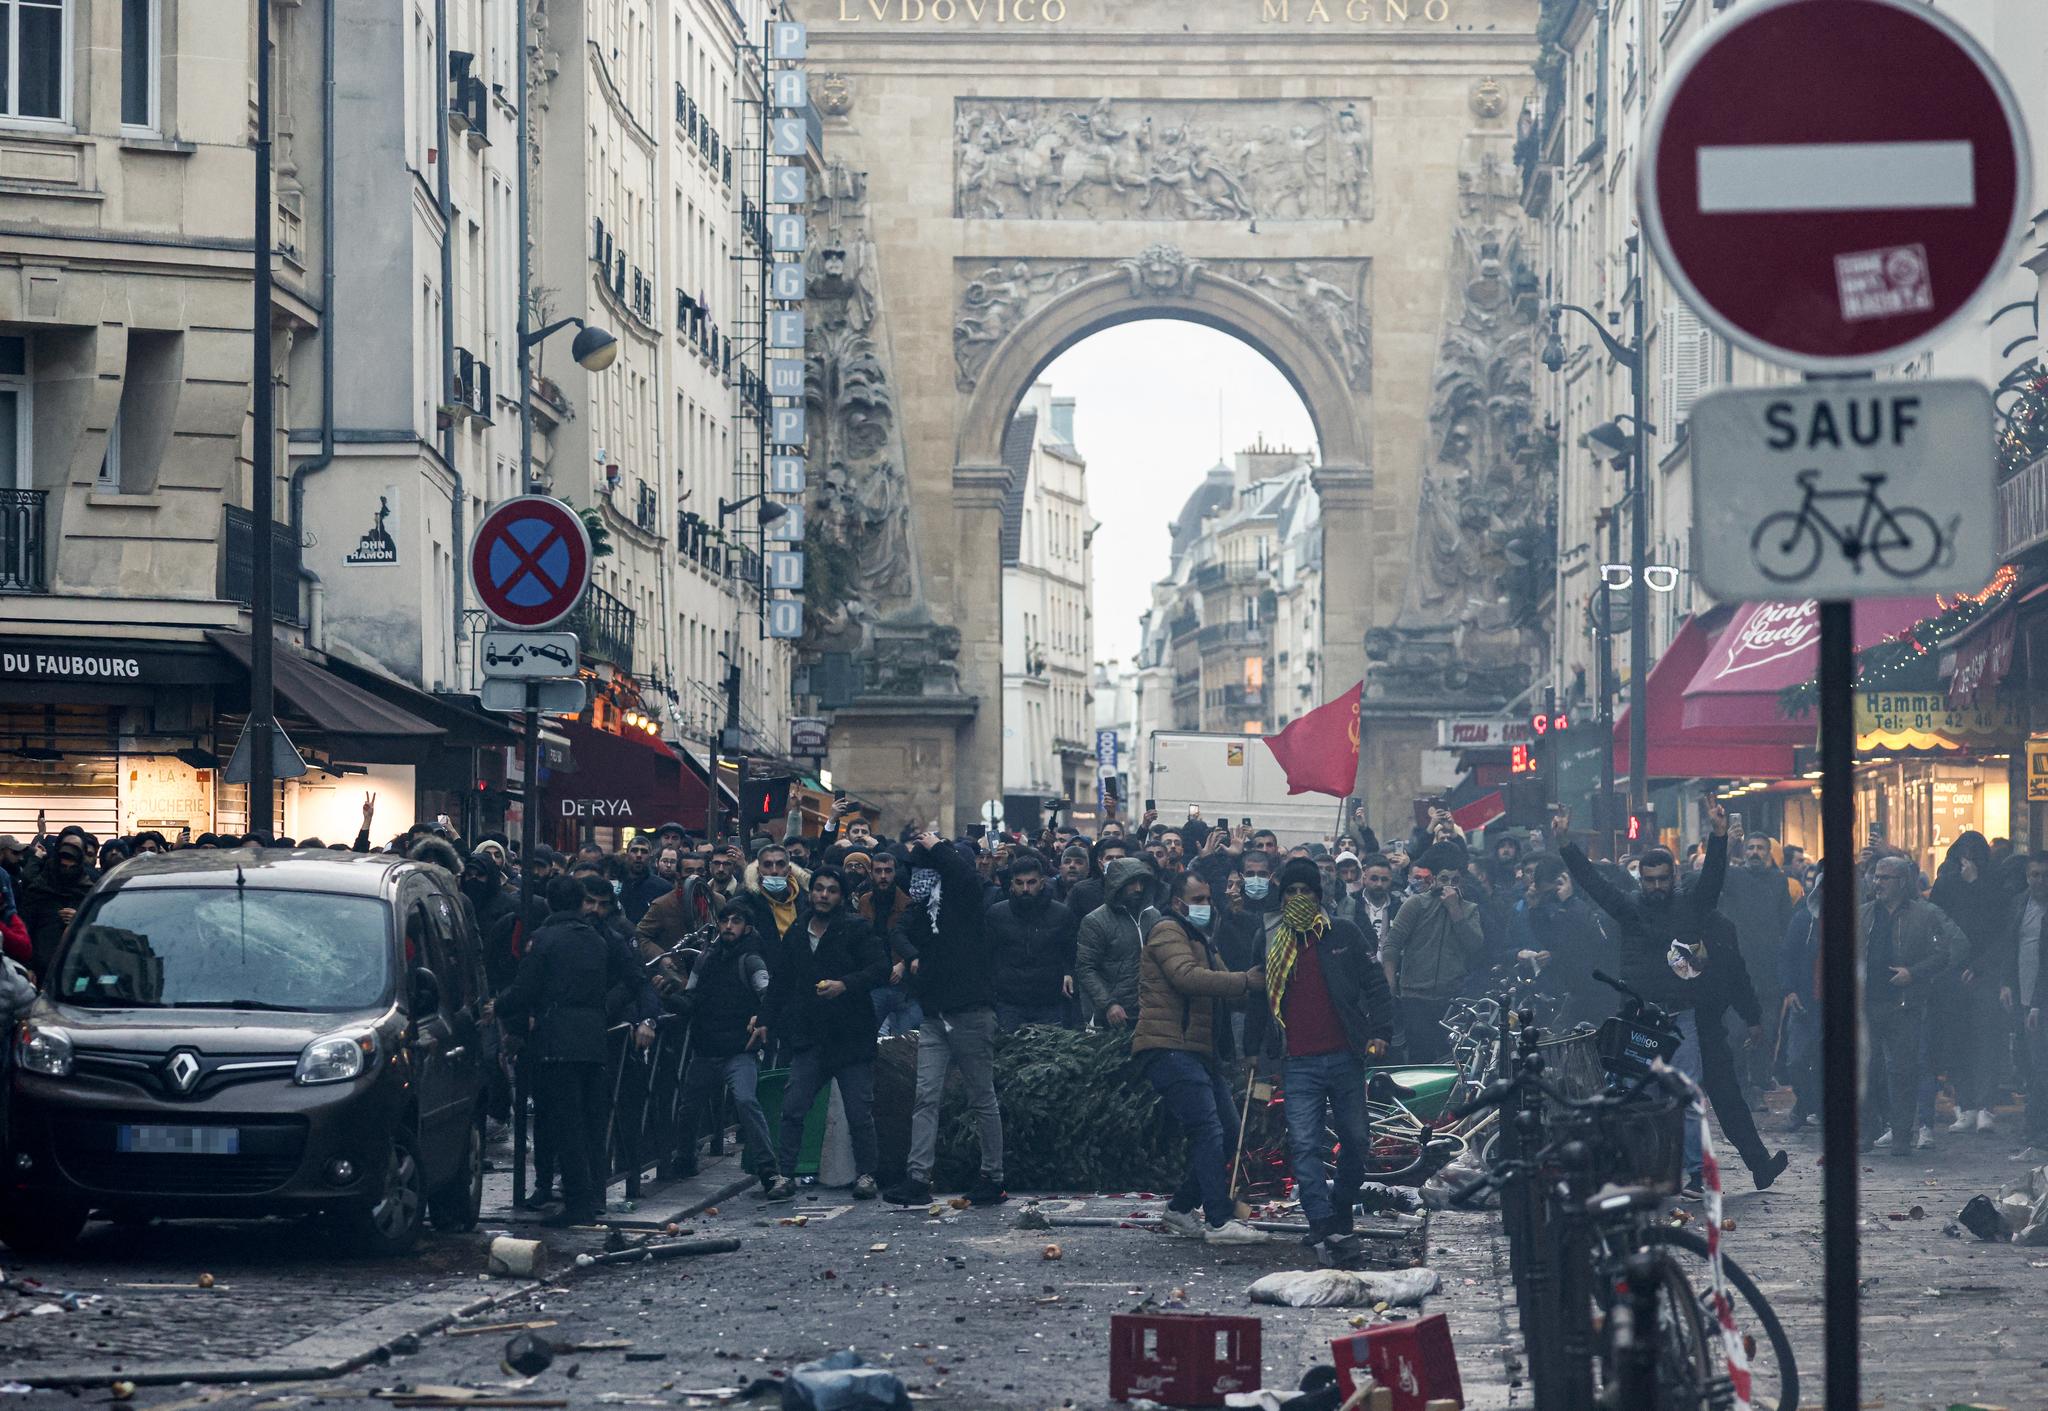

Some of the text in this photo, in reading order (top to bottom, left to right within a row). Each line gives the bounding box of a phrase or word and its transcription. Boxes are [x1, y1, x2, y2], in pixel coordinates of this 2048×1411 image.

[838, 0, 1449, 22] LVDOVICO MAGNO
[776, 25, 800, 634] PASSAGE DU PRADO
[1764, 397, 1920, 449] SAUF
[351, 550, 393, 560] HAMON
[1736, 618, 1814, 656] Lady
[3, 653, 140, 677] DU FAUBOURG
[1875, 714, 1904, 729] Tel:
[1915, 714, 1932, 728] 01
[159, 769, 176, 783] LA
[561, 799, 633, 816] DERYA
